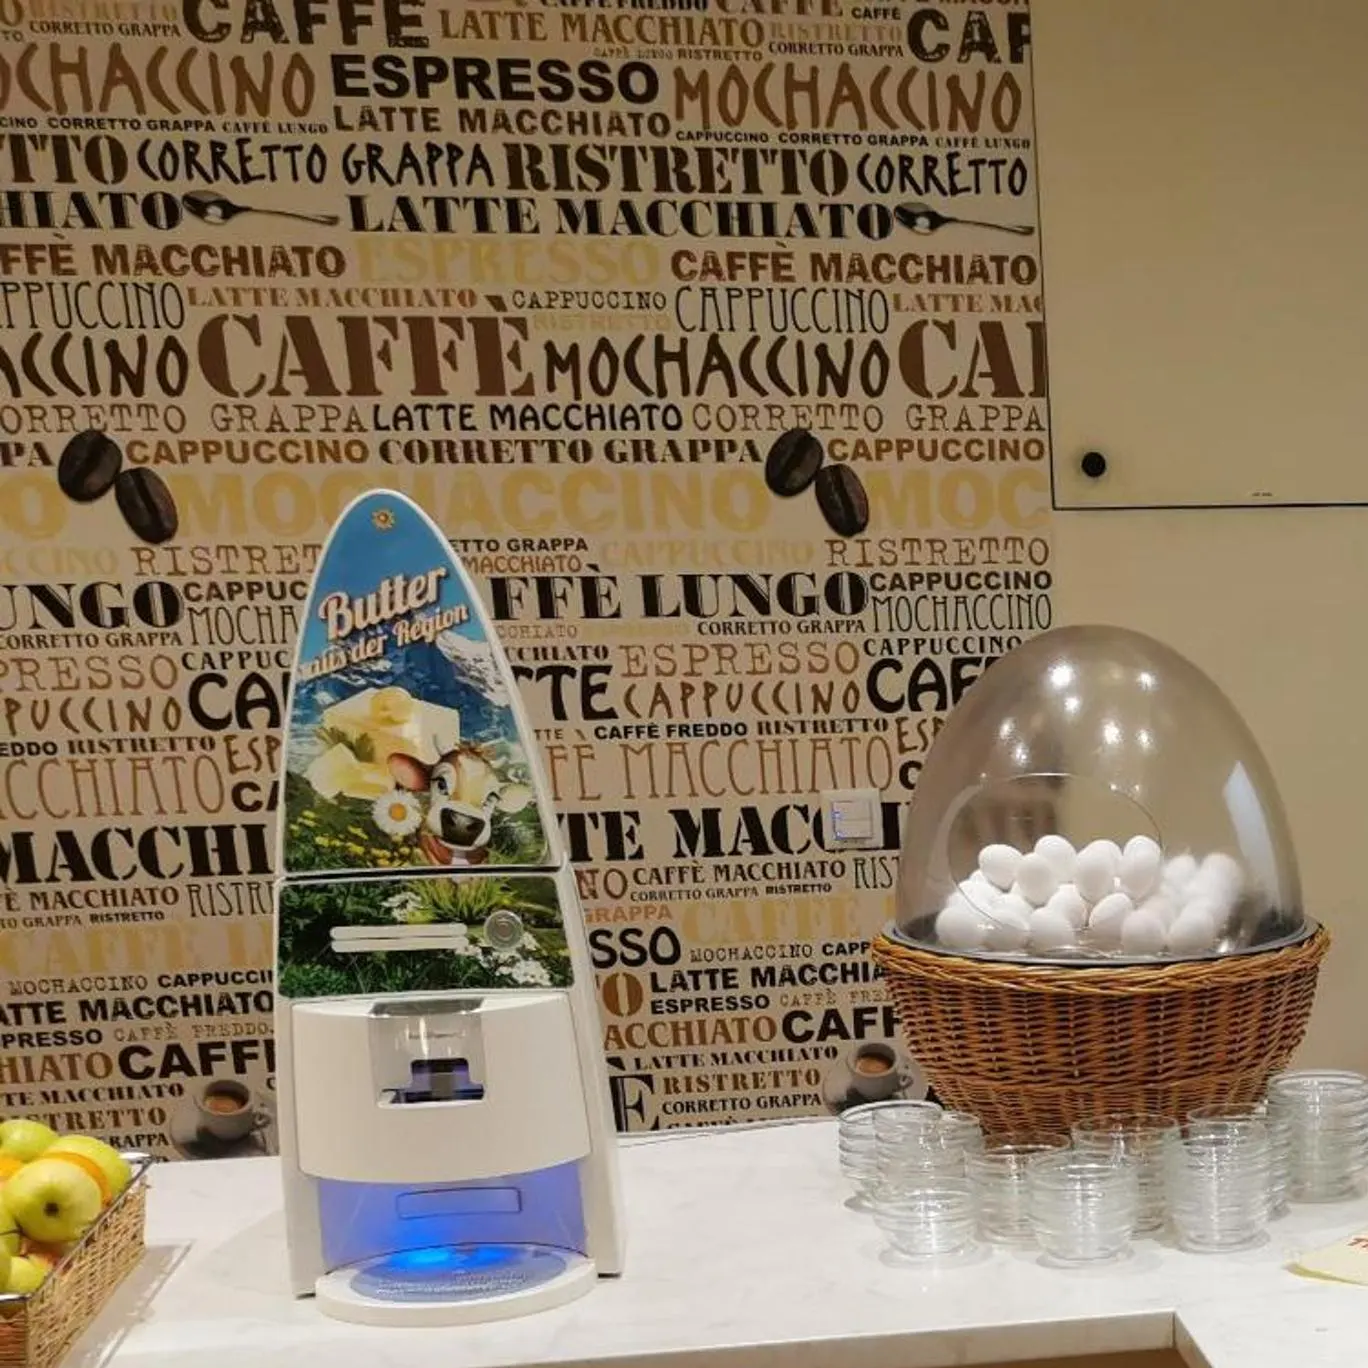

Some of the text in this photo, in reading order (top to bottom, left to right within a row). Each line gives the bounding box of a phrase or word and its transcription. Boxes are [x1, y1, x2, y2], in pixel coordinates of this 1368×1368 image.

[30, 20, 181, 38] CORRETTO GRAPPA
[438, 9, 765, 48] LATTE MACCHIATO
[677, 48, 764, 61] RISTRETTO
[768, 41, 904, 57] CORRETTO GRAPPA
[330, 53, 660, 104] ESPRESSO
[672, 61, 1023, 133] MOCHACCINO
[47, 116, 216, 134] CORRETTO GRAPPA
[277, 121, 329, 135] LUNGO
[333, 104, 671, 138] LATTE MACCHIATO
[676, 130, 769, 144] CAPPUCCINO
[777, 132, 930, 148] CORRETTO GRAPPA
[984, 136, 1031, 151] LUNGO
[137, 137, 496, 187] CORRETTO GRAPPA
[503, 141, 850, 197] RISTRETTO
[857, 150, 1029, 198] CORRETTO
[345, 194, 896, 240] LATTE MACCHIATO
[90, 243, 348, 278] MACCHIATO
[356, 238, 662, 286] ESPRESSO
[670, 241, 1039, 285] CAFFÈ MACCHIATO
[0, 280, 186, 330] PPUCCINO
[187, 286, 479, 310] LATTE MACCHIATO
[512, 290, 668, 311] CAPPUCCINO
[675, 284, 890, 334] CAPPUCCINO
[892, 292, 984, 314] LATTE
[198, 293, 536, 399] CAFFÈ
[543, 332, 892, 401] MOCHACCINO
[210, 403, 369, 434] GRAPPA
[373, 403, 685, 433] LATTE MACCHIATO
[691, 402, 1047, 434] CORRETTO GRAPPA
[125, 439, 371, 465] CAPPUCCINO
[378, 437, 764, 465] CORRETTO GRAPPA
[826, 436, 1047, 462] CAPPUCCINO
[506, 537, 589, 554] GRAPPA
[824, 537, 1049, 568] RISTRETTO
[638, 570, 870, 620] LUNGO
[869, 569, 1052, 592] CAPPUCCINO
[318, 566, 448, 642] Butter
[871, 592, 1052, 634] MOCHACCINO
[105, 632, 184, 649] GRAPPA
[350, 633, 390, 663] der
[392, 603, 470, 647] Region
[697, 619, 792, 639] CORRETTO
[796, 617, 867, 637] GRAPPA
[619, 640, 861, 680] ESPRESSO
[866, 654, 1003, 714] CAF
[622, 680, 861, 718] CAPPUCCINO
[593, 721, 748, 741] CAFFÈ FREDDO
[756, 718, 890, 738] RISTRETTO
[68, 735, 217, 755] RISTRETTO
[619, 736, 894, 800] MACCHIATO
[0, 754, 225, 821] CCHIATO
[632, 857, 847, 886] CAFFÈ MACCHIATO
[29, 885, 180, 911] MACCHIATO
[185, 879, 275, 918] RISTR
[629, 882, 833, 903] CORRETTO GRAPPA RISTRETTO
[22, 910, 166, 929] GRAPPA RISTRETTO
[690, 944, 813, 963] MOCHACCINO
[9, 972, 149, 996] MOCHACCINO
[650, 967, 740, 994] LATTE
[78, 989, 275, 1024] MACCHIATO
[650, 993, 771, 1016] ESPRESSO
[634, 1046, 840, 1073] LATTE MACCHIATO
[40, 1081, 186, 1105] MACCHIATO
[662, 1067, 823, 1097] RISTRETTO
[661, 1091, 823, 1116] CORRETTO GRAPPA
